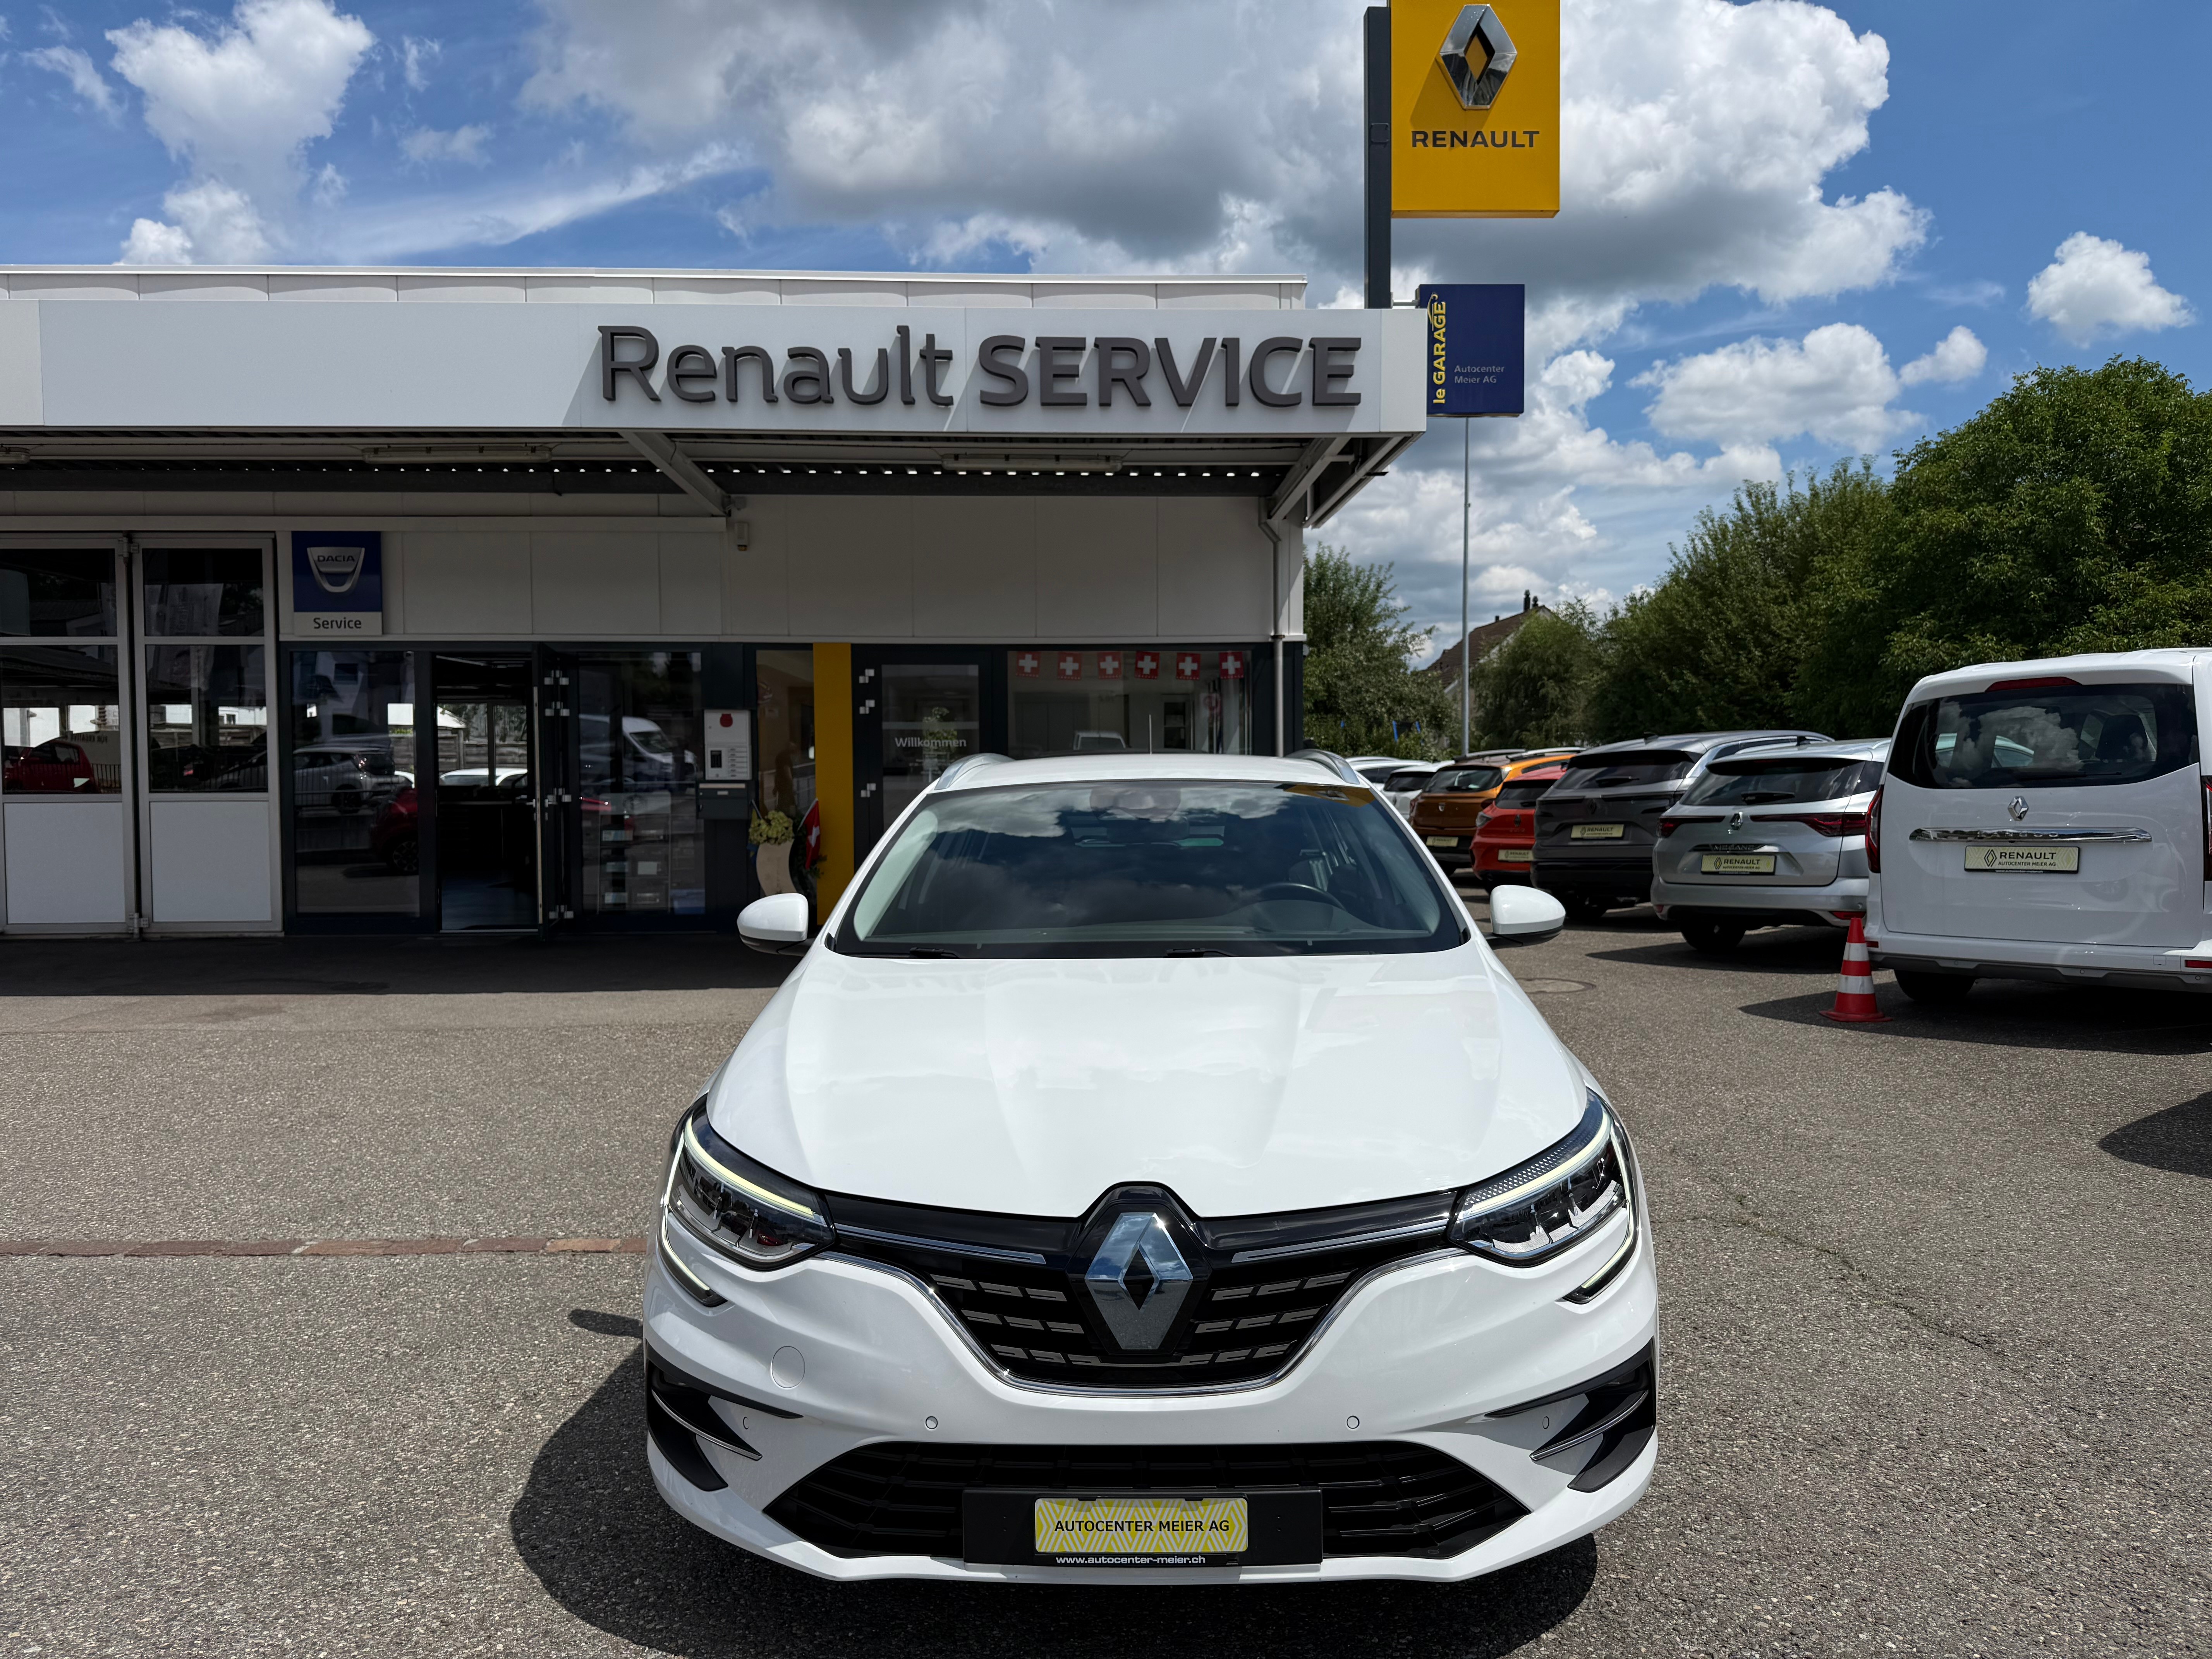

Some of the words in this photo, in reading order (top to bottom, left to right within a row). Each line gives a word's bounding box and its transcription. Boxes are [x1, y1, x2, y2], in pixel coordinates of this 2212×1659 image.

[1412, 131, 1540, 148] RENAULT
[1433, 301, 1446, 385] GARAGE
[598, 325, 953, 407] Renault
[979, 335, 1362, 408] SERVICE
[1433, 388, 1446, 404] le
[313, 617, 361, 629] Service
[895, 737, 967, 747] Willkommen
[1054, 1520, 1153, 1532] AUTOCENTER
[1158, 1520, 1204, 1531] MEIER
[1209, 1520, 1230, 1532] AG
[1056, 1555, 1206, 1564] www.autocenter-meier.ch
